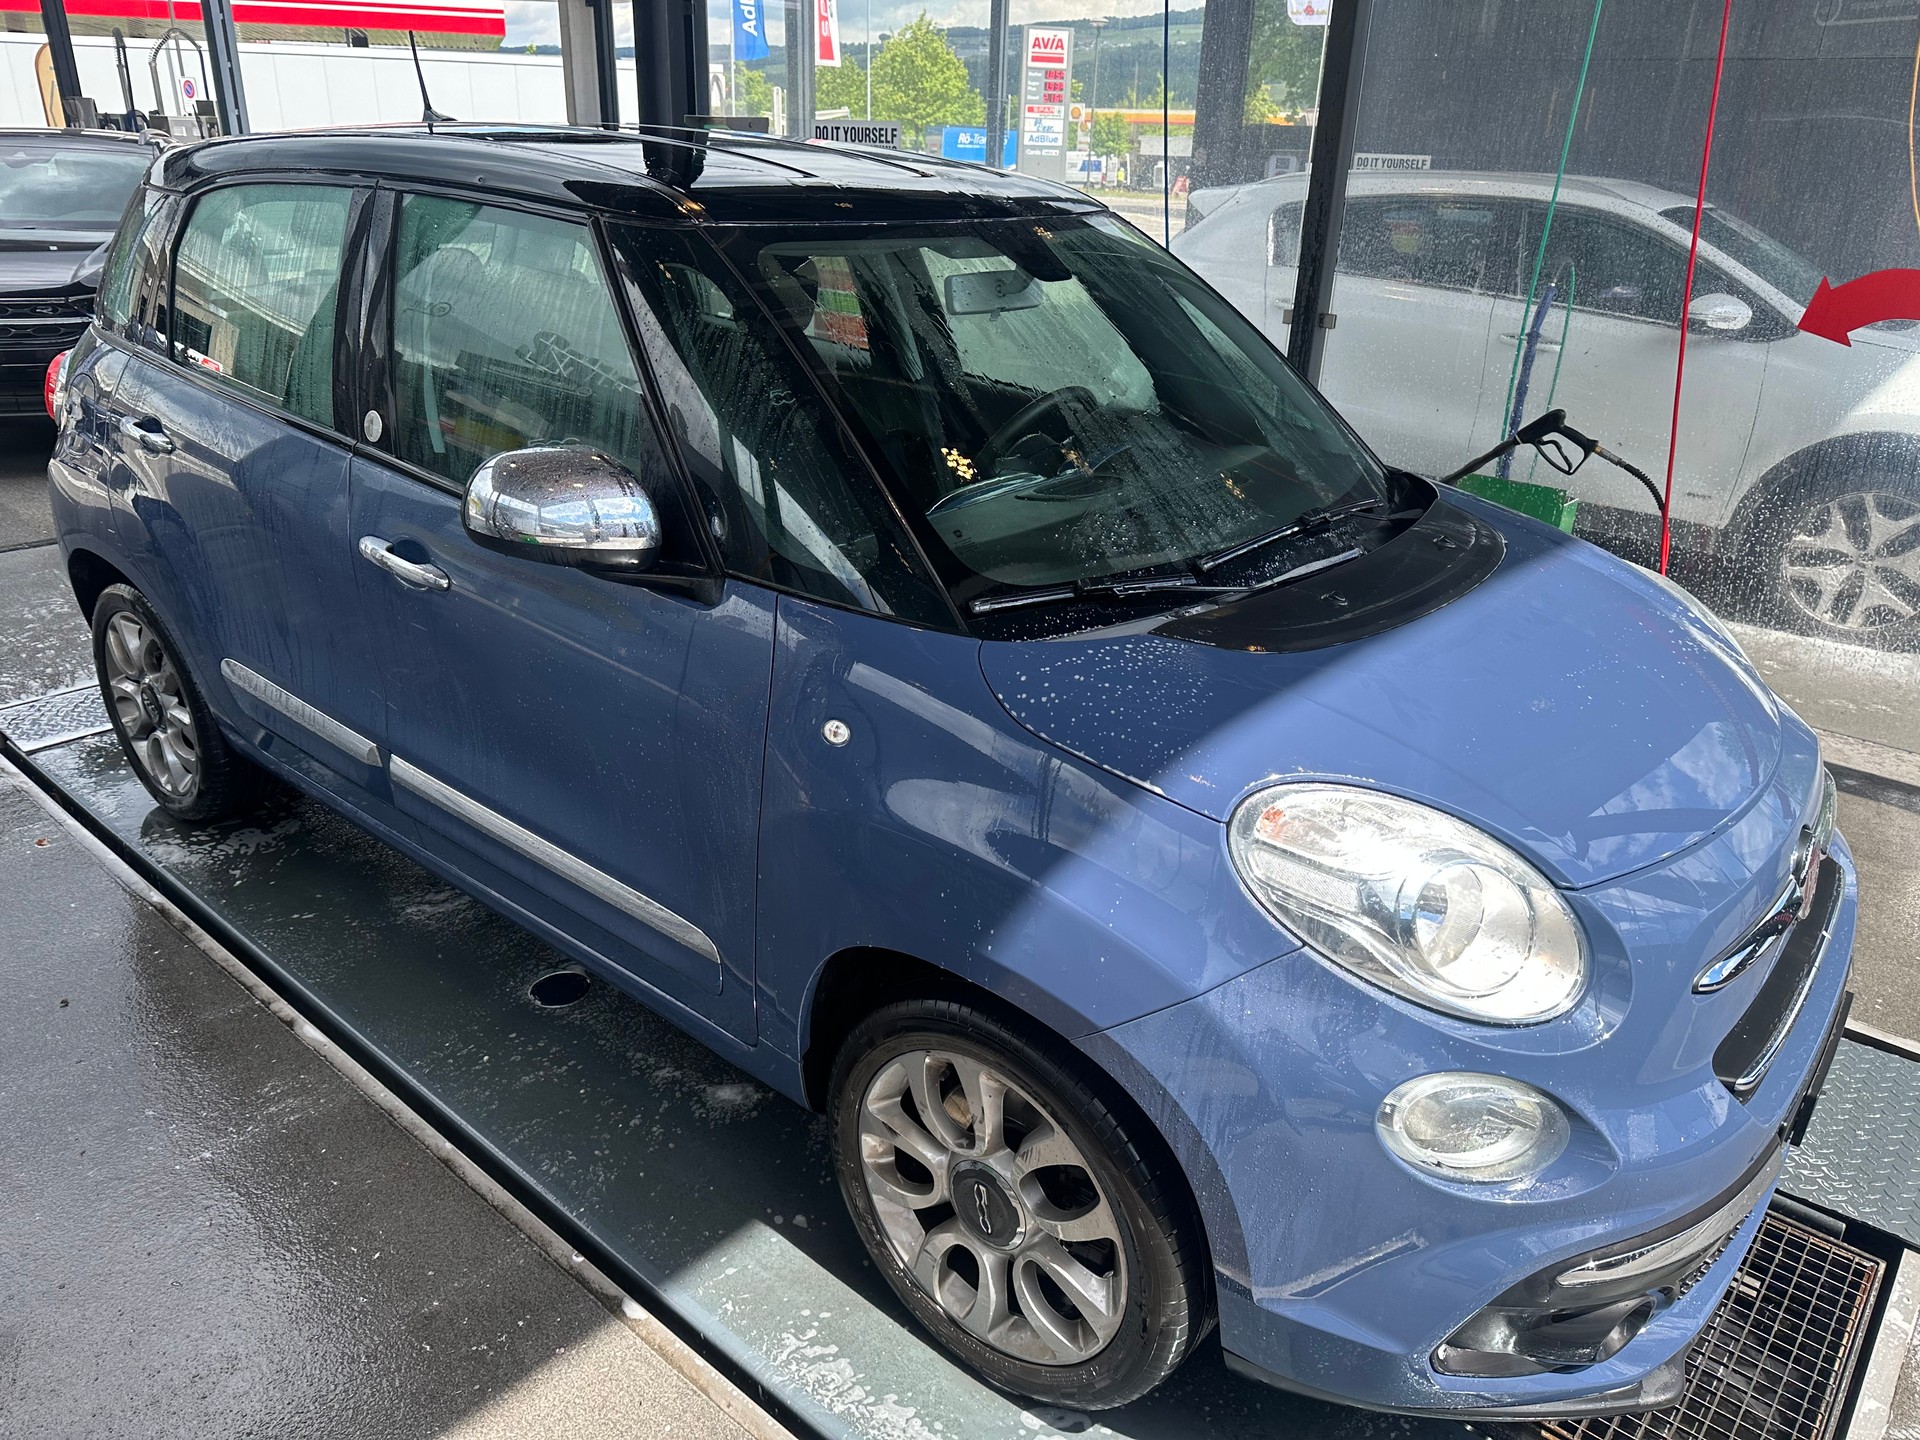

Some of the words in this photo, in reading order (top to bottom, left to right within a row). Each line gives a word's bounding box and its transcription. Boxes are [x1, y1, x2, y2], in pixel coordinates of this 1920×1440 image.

[741, 0, 758, 37] Ad
[815, 126, 829, 140] DO
[831, 126, 841, 142] IT
[843, 126, 898, 144] YOURSELF
[1028, 134, 1059, 144] AdBlue
[1356, 157, 1369, 168] DO
[1370, 157, 1380, 168] IT
[1381, 158, 1428, 170] YOURSELF
